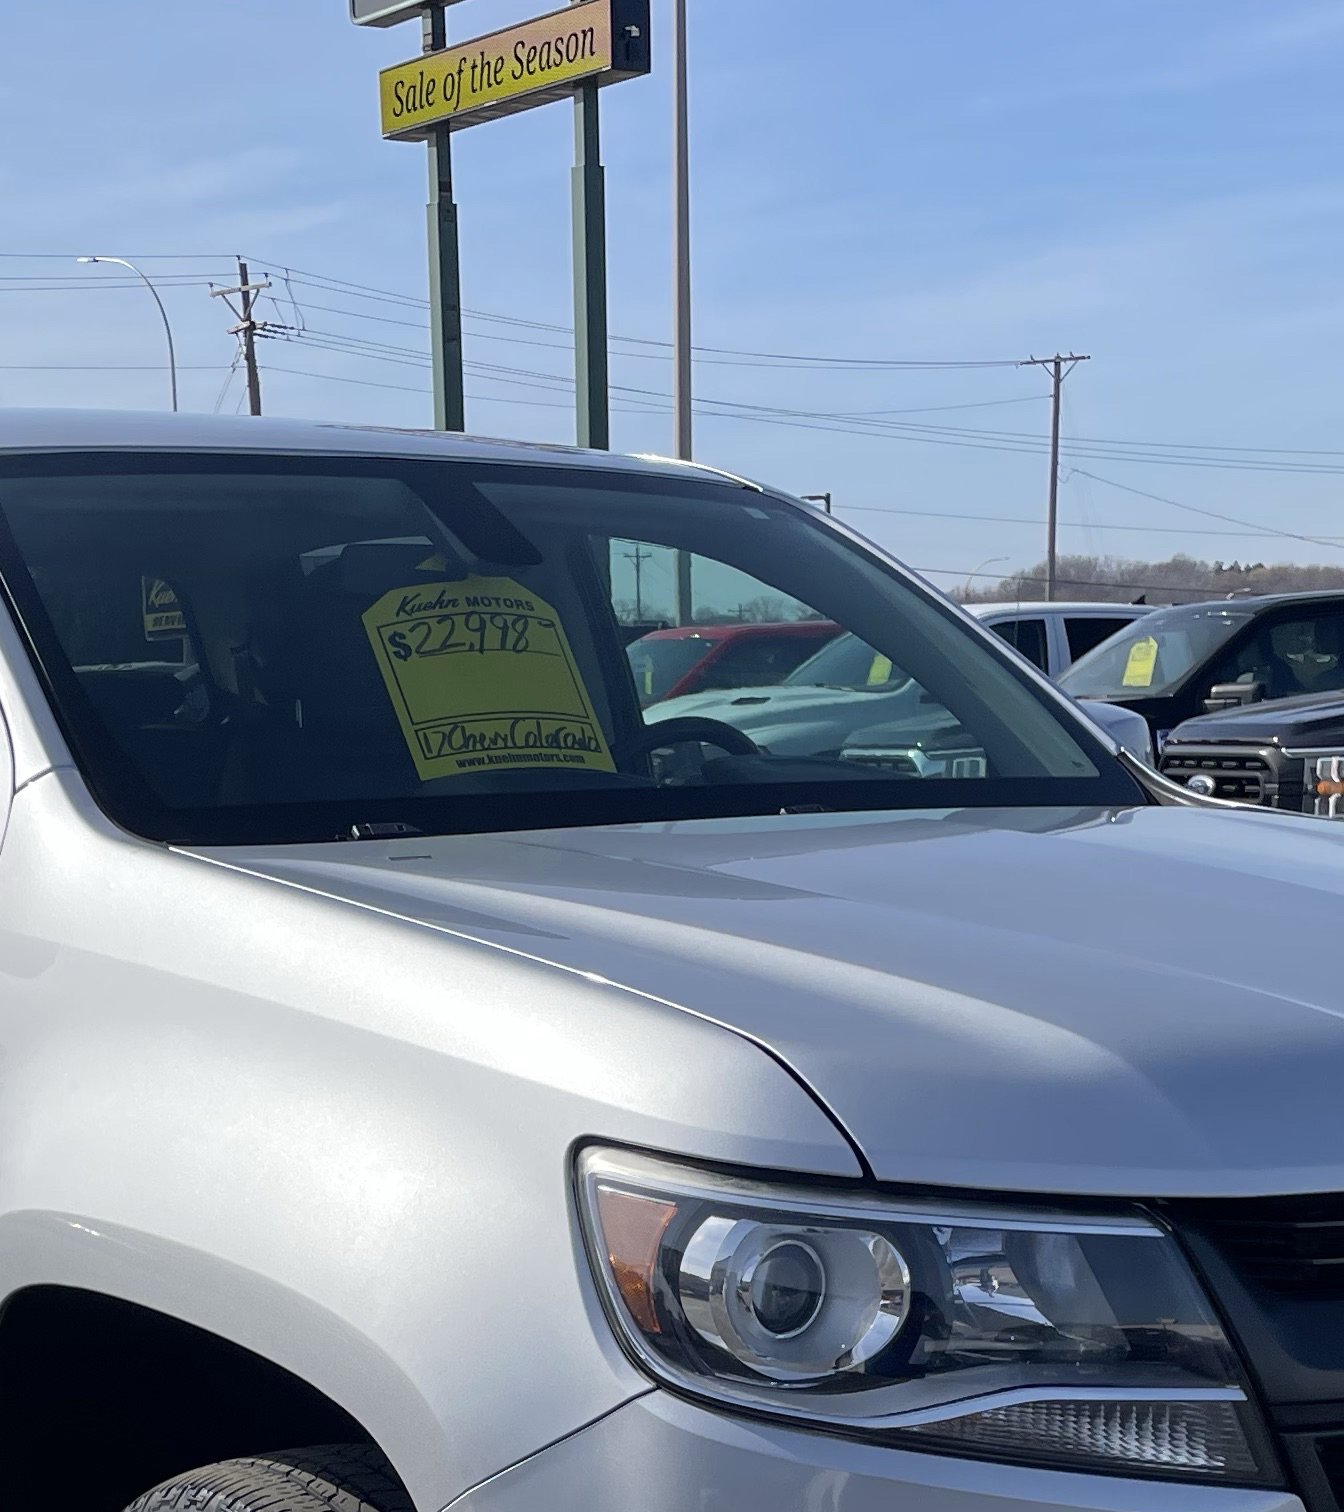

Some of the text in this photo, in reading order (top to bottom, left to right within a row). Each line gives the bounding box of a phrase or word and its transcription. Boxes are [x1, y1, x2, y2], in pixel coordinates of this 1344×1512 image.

[392, 26, 596, 117] Sale of the Season
[396, 590, 535, 617] Kuehn MOTORS
[456, 752, 585, 769] www.kuehnmotors.com
